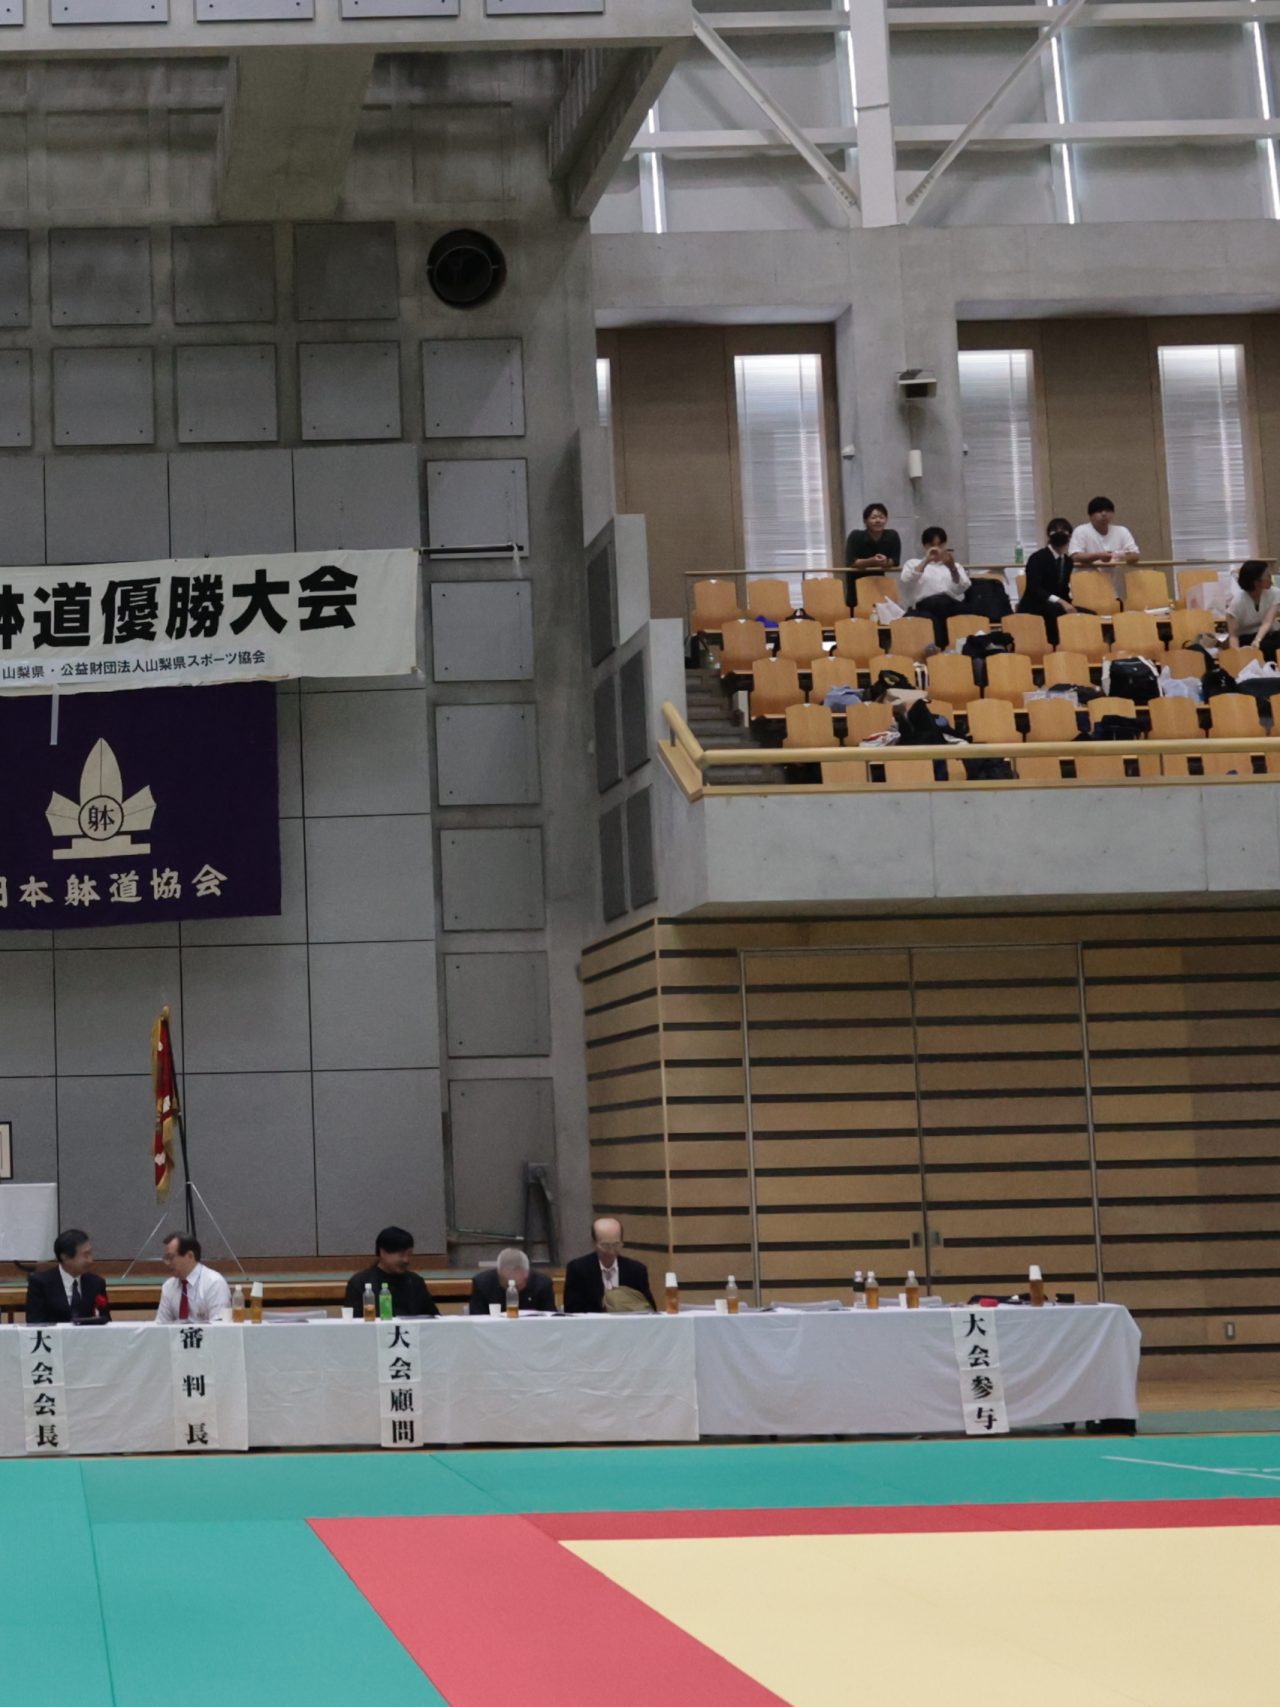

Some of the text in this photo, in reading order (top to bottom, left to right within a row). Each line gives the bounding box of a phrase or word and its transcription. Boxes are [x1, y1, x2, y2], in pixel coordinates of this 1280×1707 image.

[29, 1329, 60, 1447] 大会会長
[387, 1325, 415, 1443] 大会顧問
[962, 1313, 998, 1430] 大会参与
